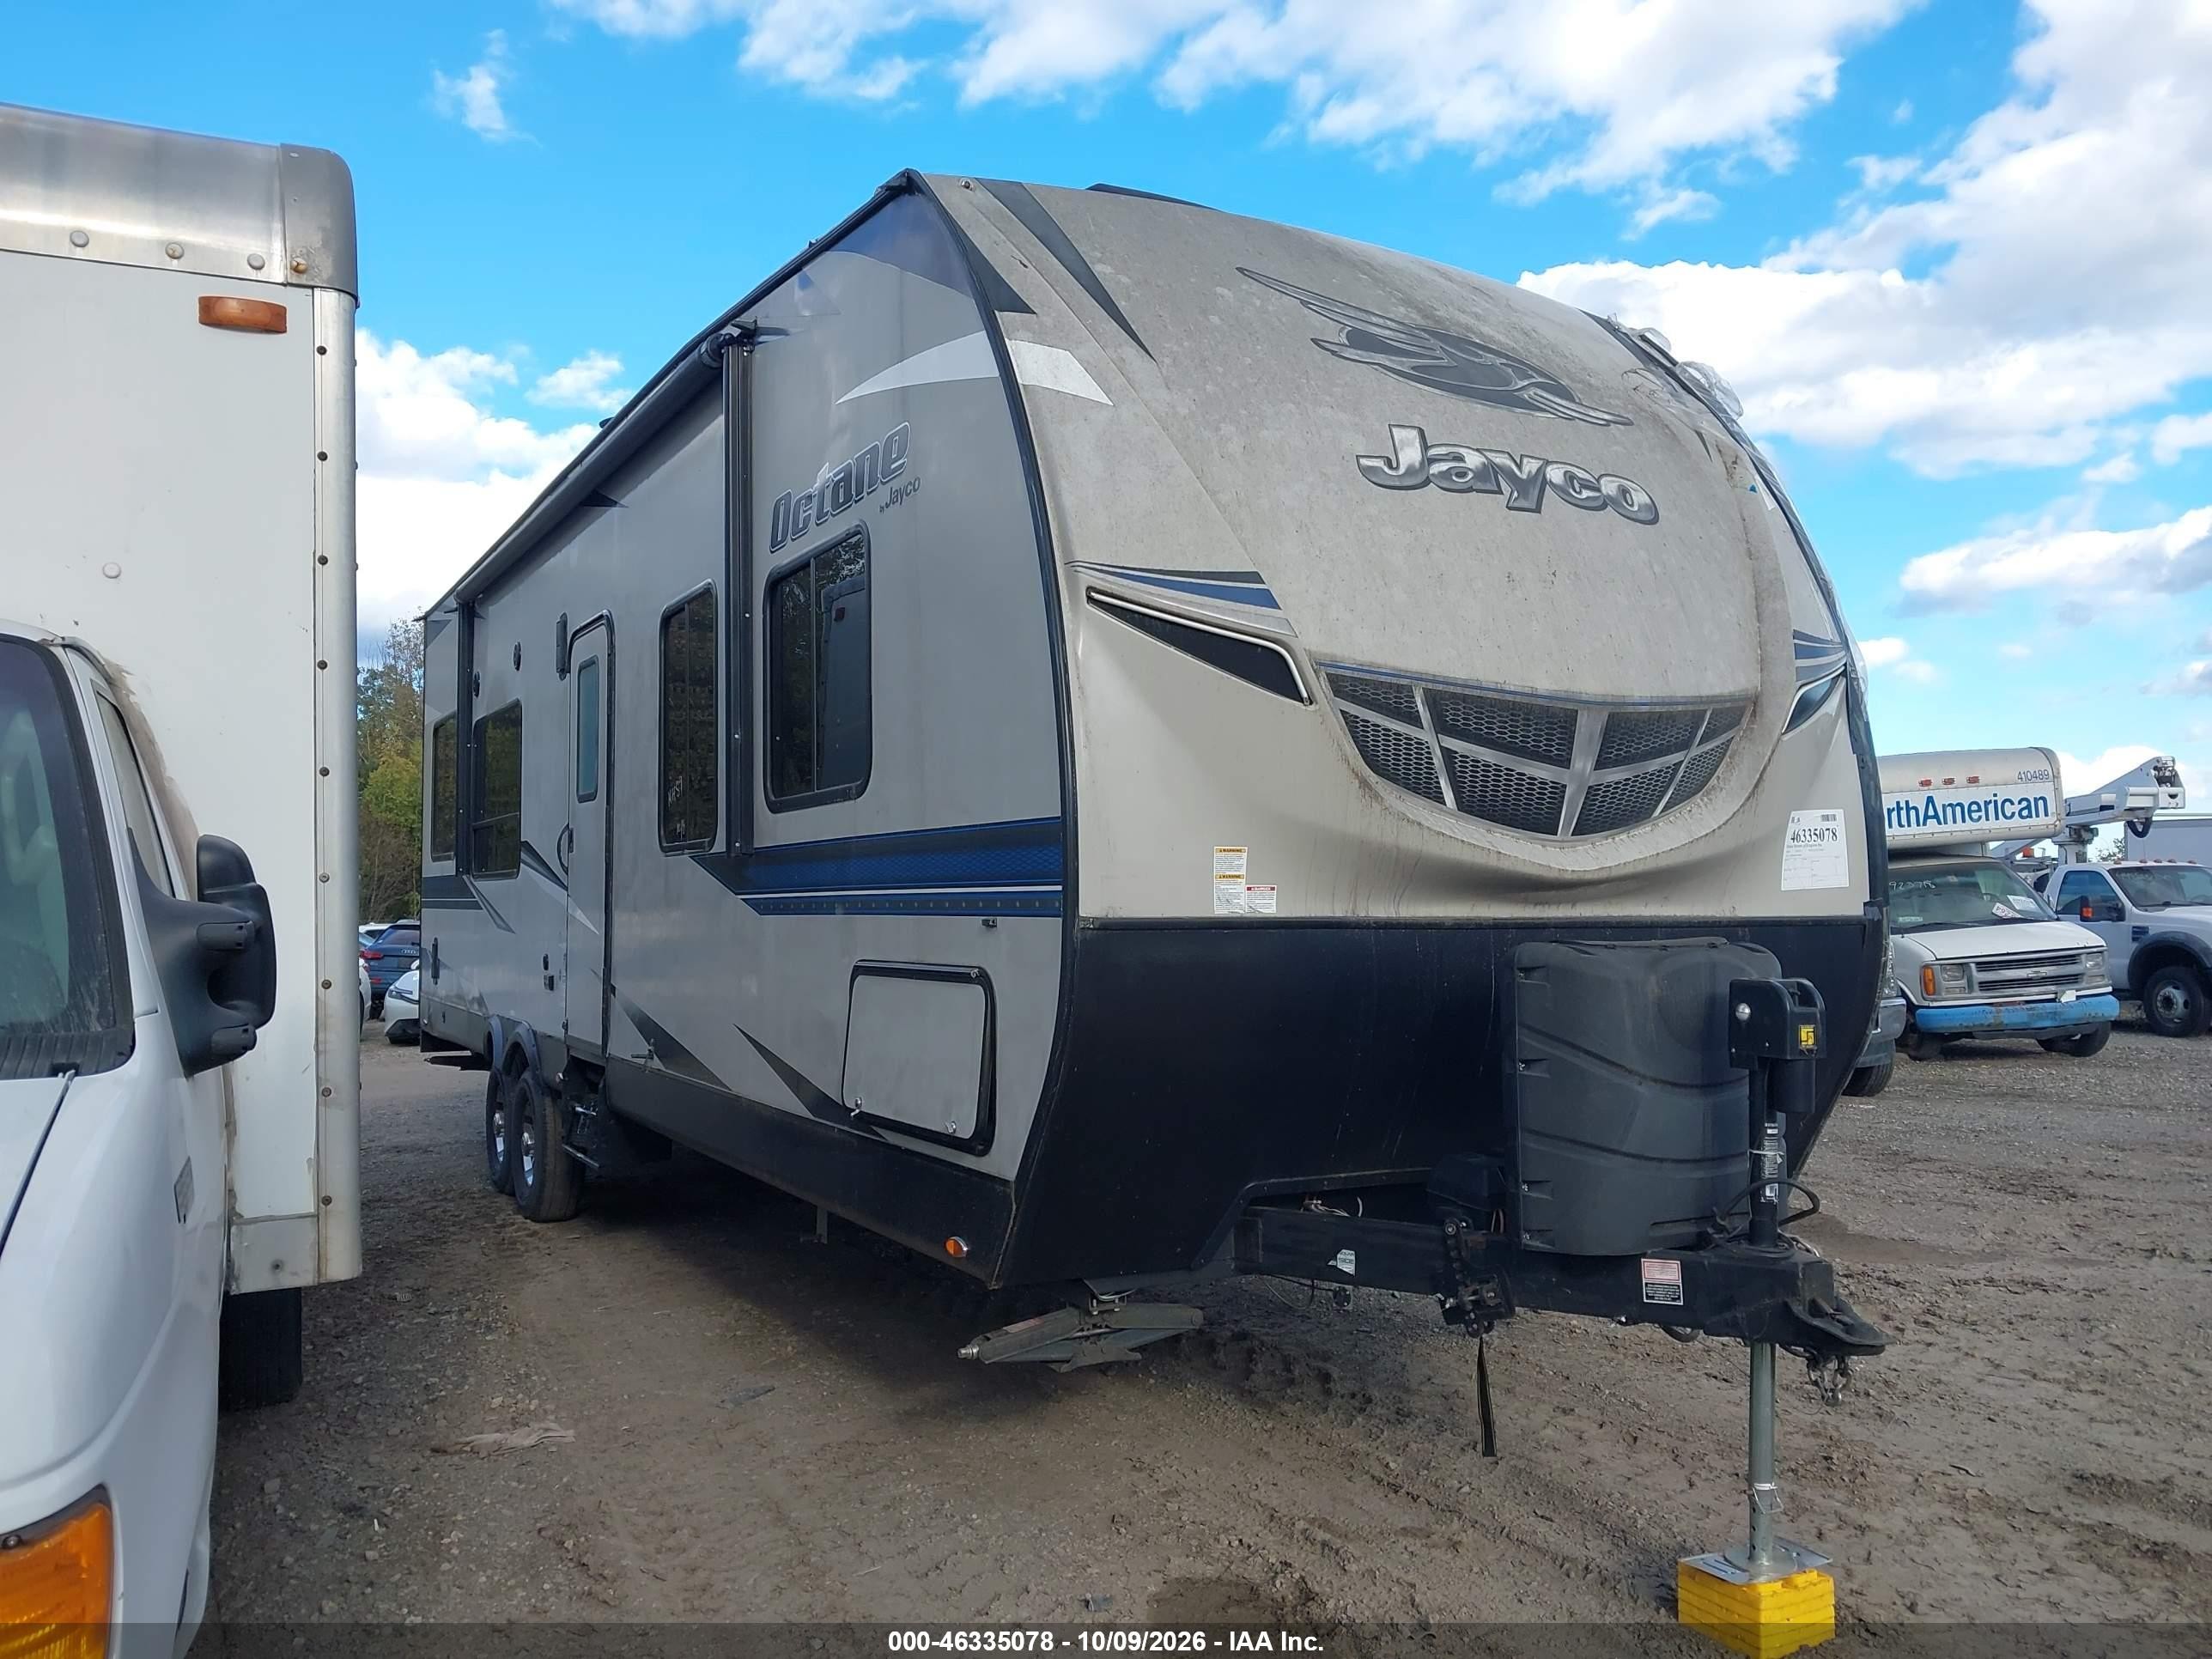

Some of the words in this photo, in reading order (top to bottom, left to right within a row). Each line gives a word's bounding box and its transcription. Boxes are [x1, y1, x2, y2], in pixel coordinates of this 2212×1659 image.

[769, 421, 911, 554] Octane
[1356, 423, 1660, 525] Jayco
[878, 503, 885, 514] by
[885, 476, 921, 509] Jayco
[2017, 769, 2050, 782] 410489
[1790, 827, 1838, 843] 46335078
